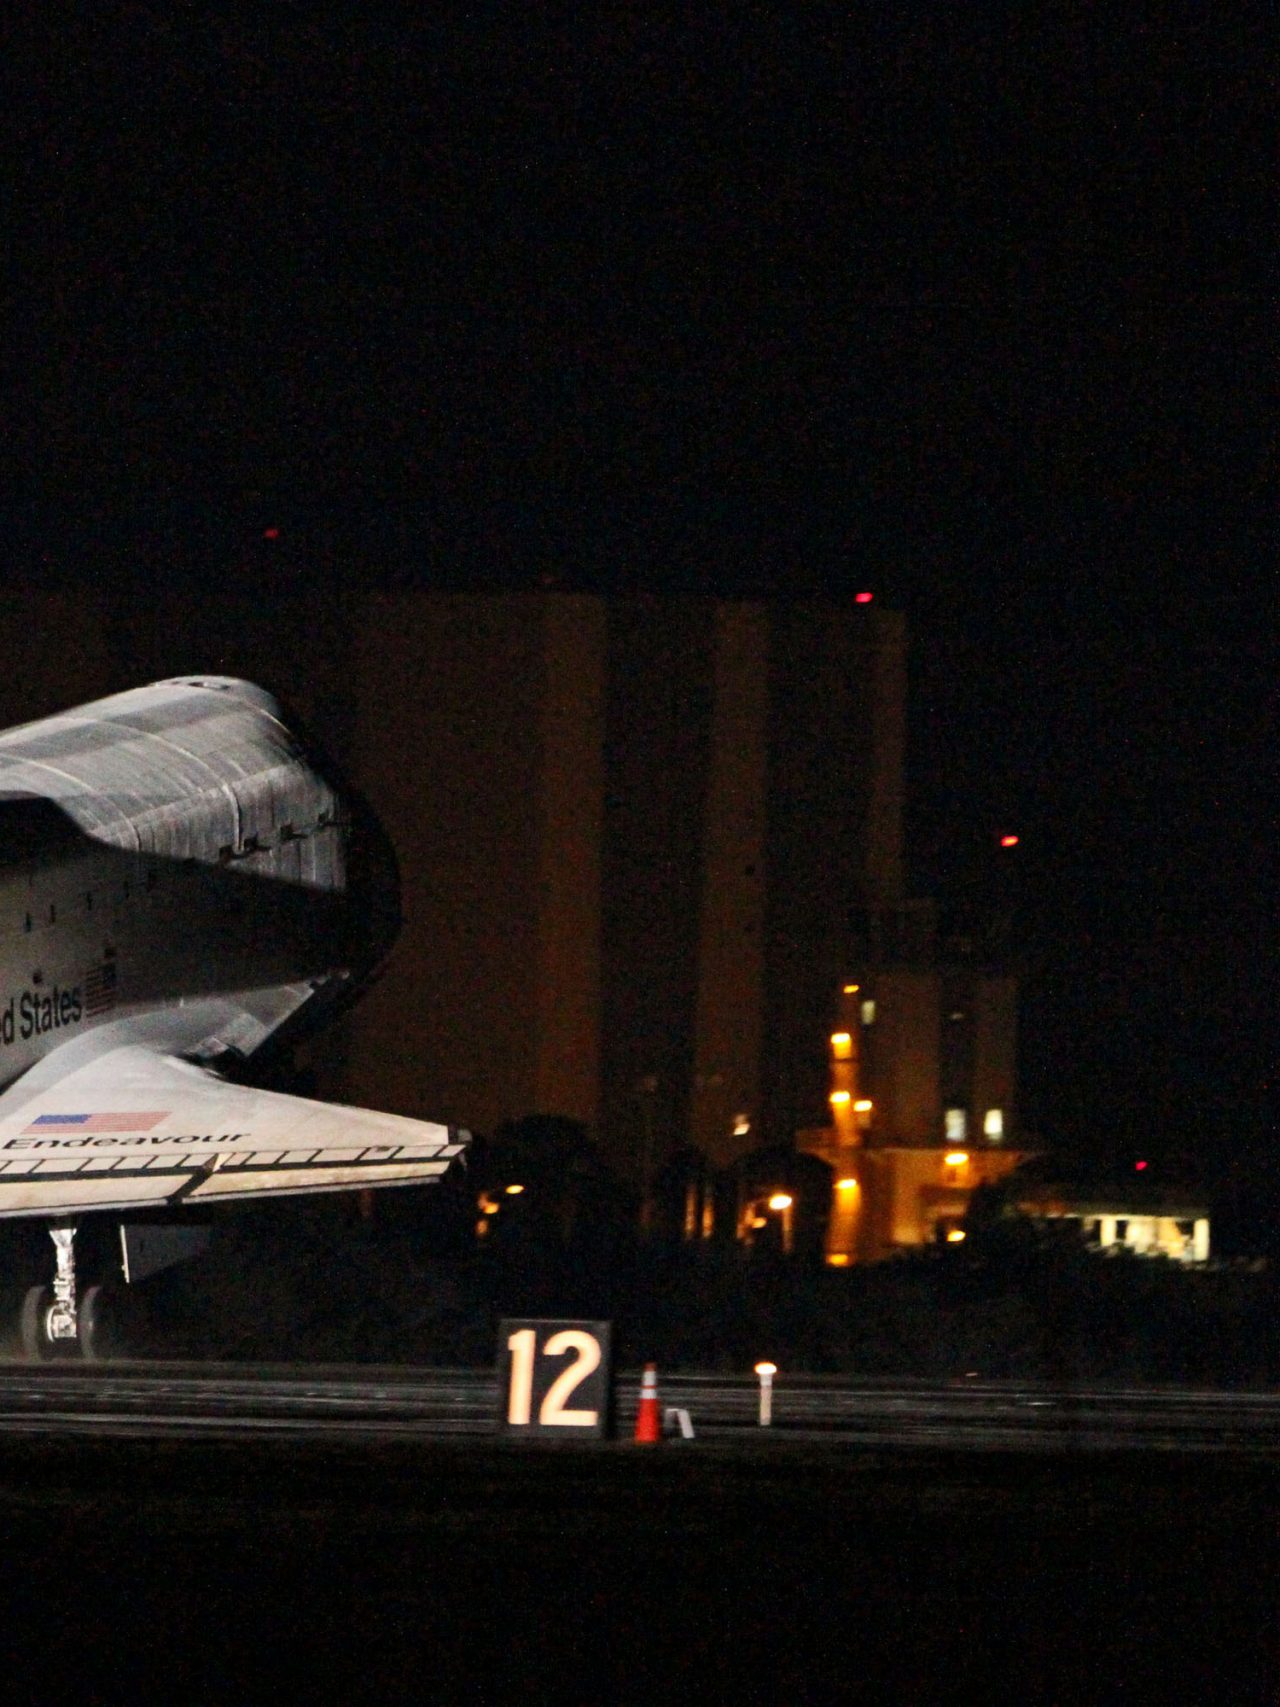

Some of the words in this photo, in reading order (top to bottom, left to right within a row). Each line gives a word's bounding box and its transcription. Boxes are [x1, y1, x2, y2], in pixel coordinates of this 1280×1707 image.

[19, 984, 82, 1040] States
[1, 1132, 252, 1150] Endeavour
[508, 1329, 602, 1427] 12
